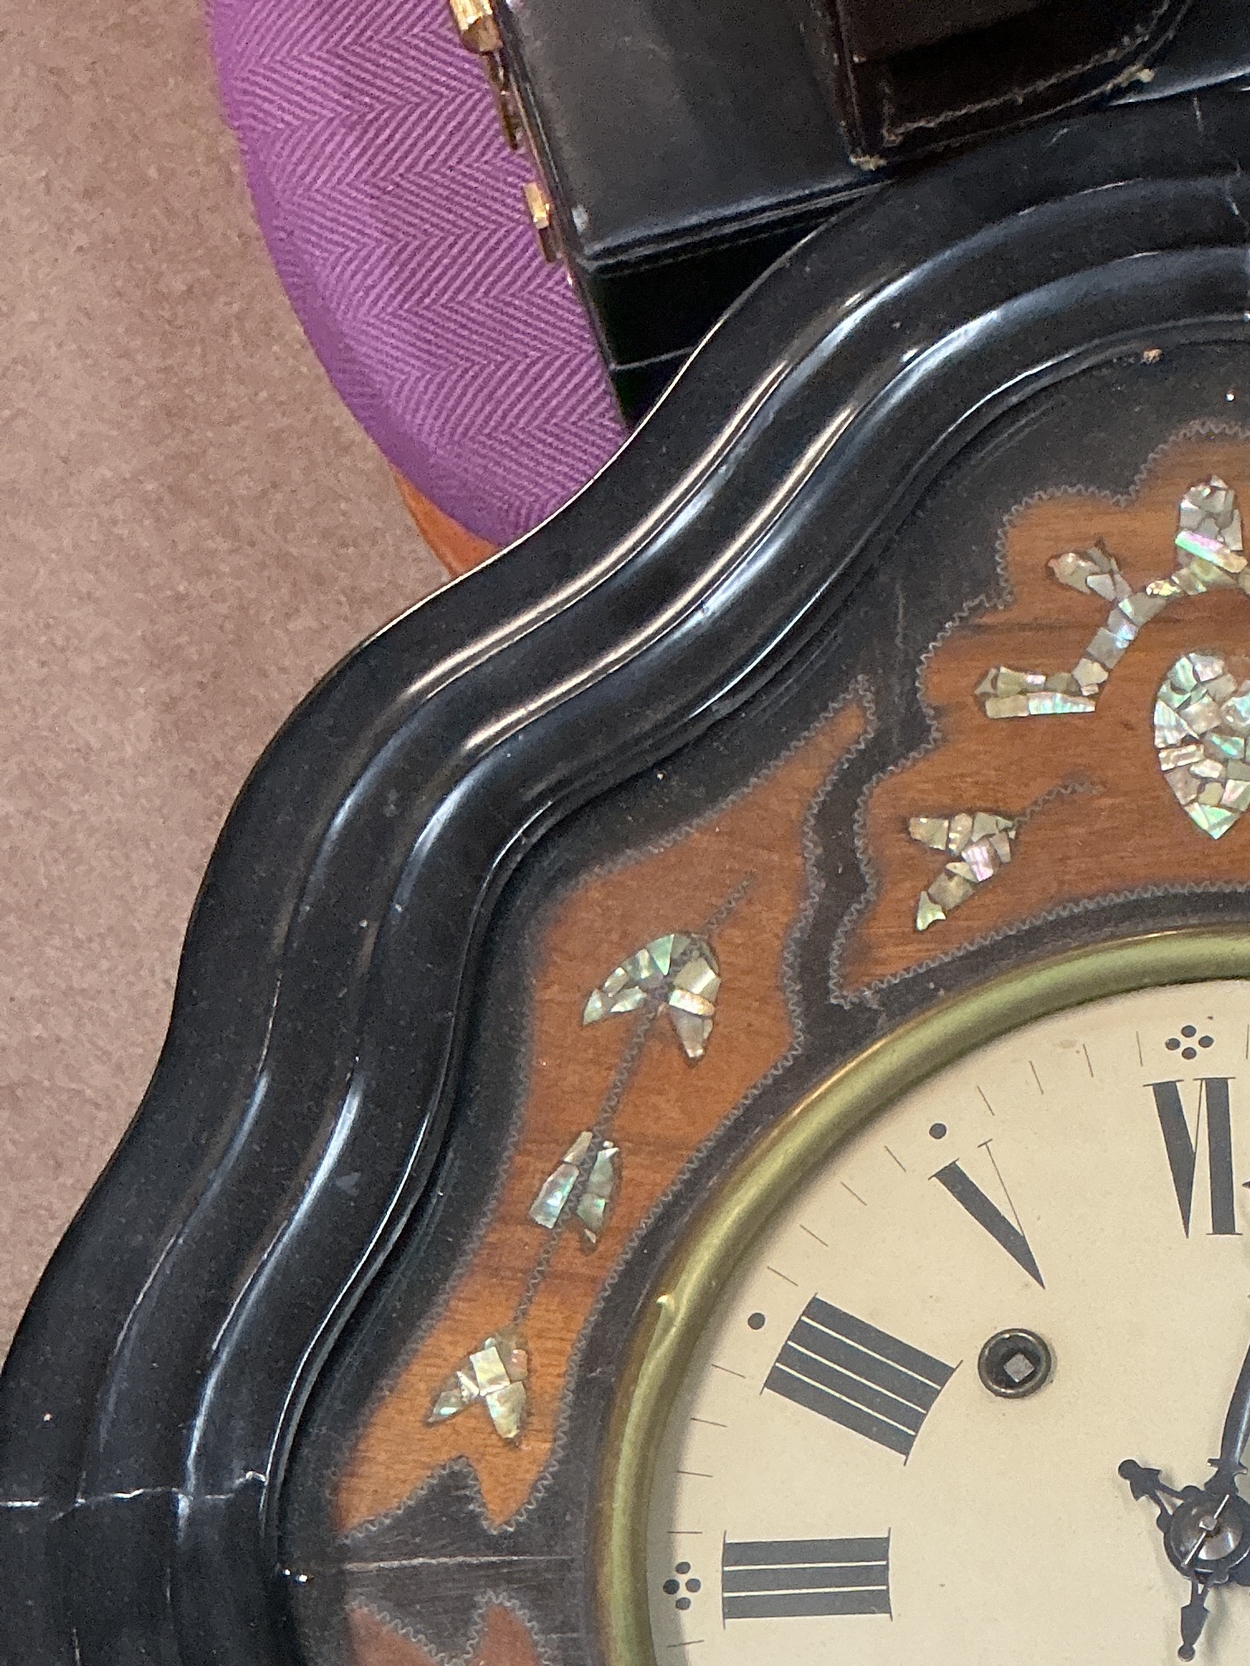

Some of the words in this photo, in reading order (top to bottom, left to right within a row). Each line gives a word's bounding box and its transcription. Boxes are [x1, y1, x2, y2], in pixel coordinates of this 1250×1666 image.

[928, 1139, 1045, 1289] V
[1143, 1077, 1242, 1239] VI
[760, 1293, 963, 1466] IIII
[721, 1526, 893, 1630] III
